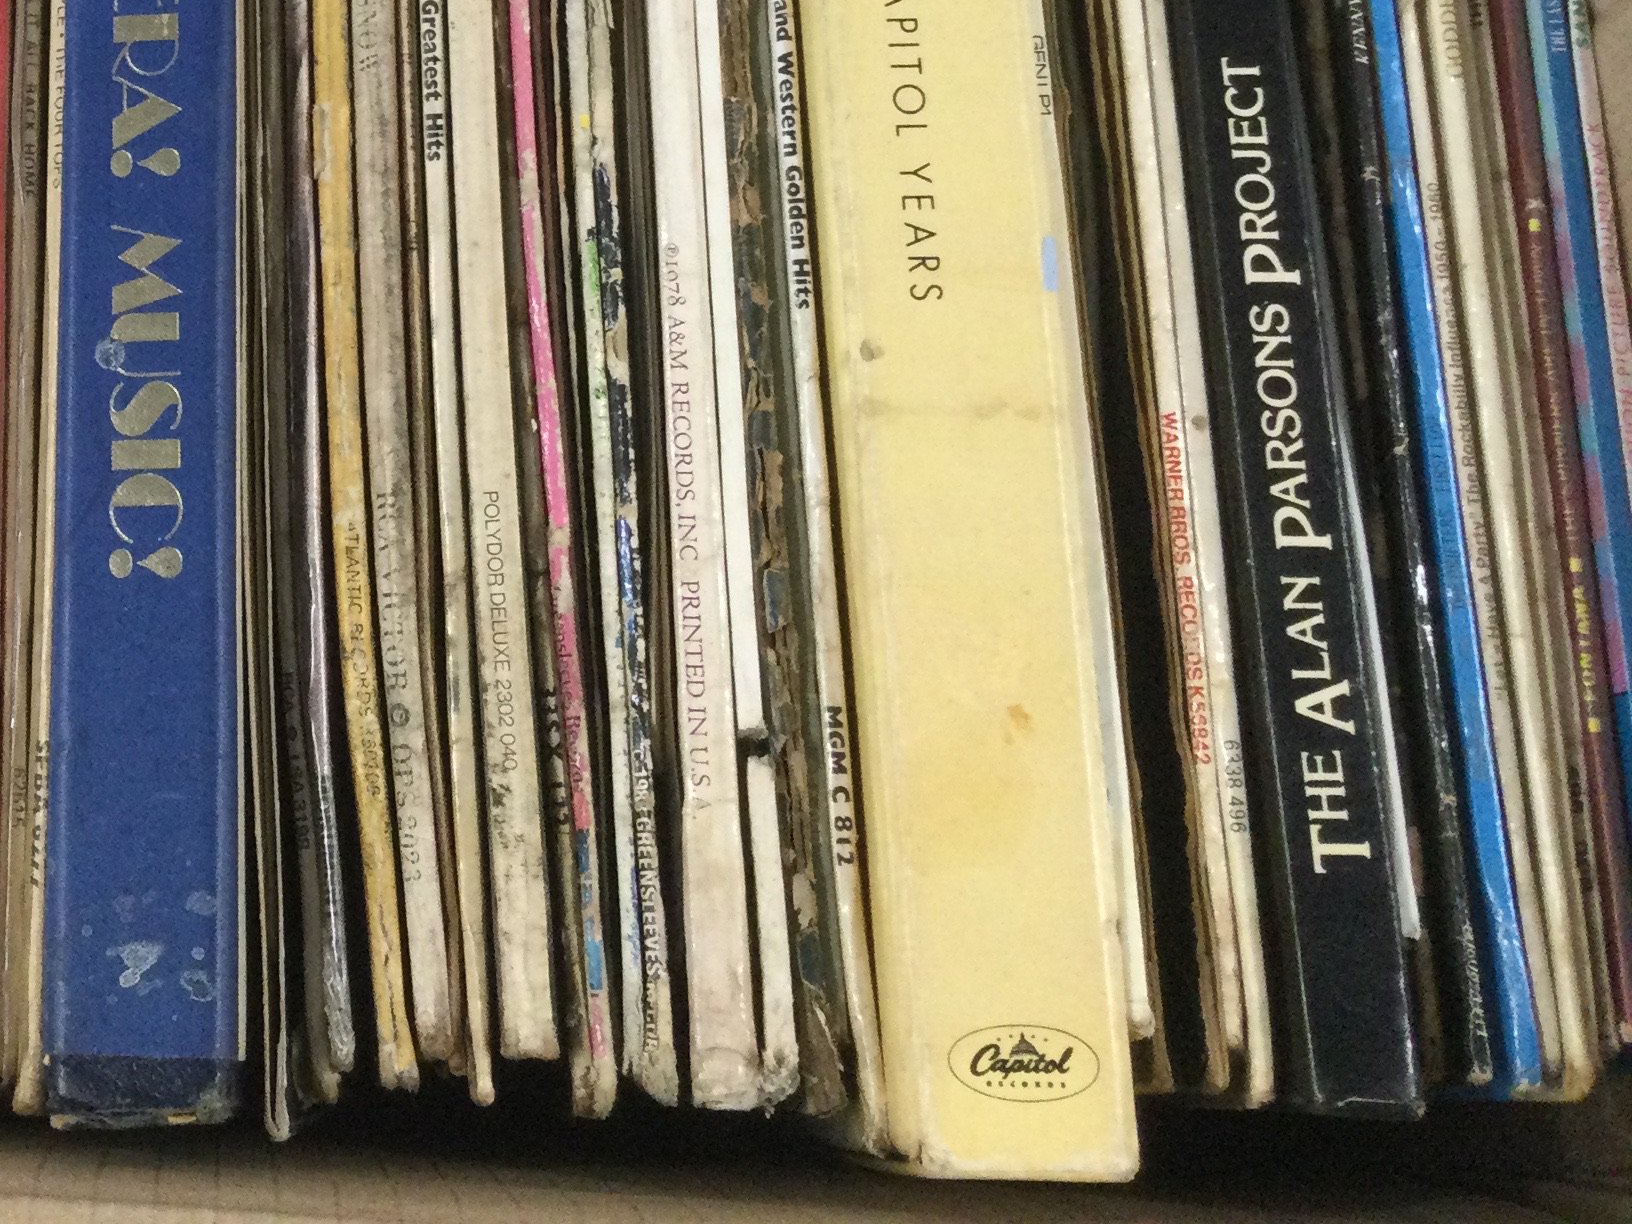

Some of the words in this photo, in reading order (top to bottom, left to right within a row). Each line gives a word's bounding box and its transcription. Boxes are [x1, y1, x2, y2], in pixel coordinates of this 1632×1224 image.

[772, 0, 792, 42] and
[424, 112, 444, 162] Hits
[776, 50, 800, 158] Western
[784, 164, 808, 250] Golden
[1221, 56, 1302, 286] PROJECT
[899, 162, 944, 302] YEARS
[791, 258, 813, 310] Hits
[108, 225, 184, 579] MUSIC!
[1249, 300, 1332, 549] PARSONS
[481, 490, 504, 586] POLYDOR
[487, 592, 510, 672] DELUXE
[1269, 572, 1357, 734] ALAN
[494, 678, 514, 726] 2302
[825, 706, 847, 774] MGM
[498, 732, 518, 770] 040
[831, 784, 850, 804] C
[1227, 796, 1248, 832] 496
[1303, 749, 1372, 875] THE
[833, 814, 856, 866] 812
[634, 816, 660, 976] GREENSLEEVES
[969, 1043, 1075, 1080] Capitol
